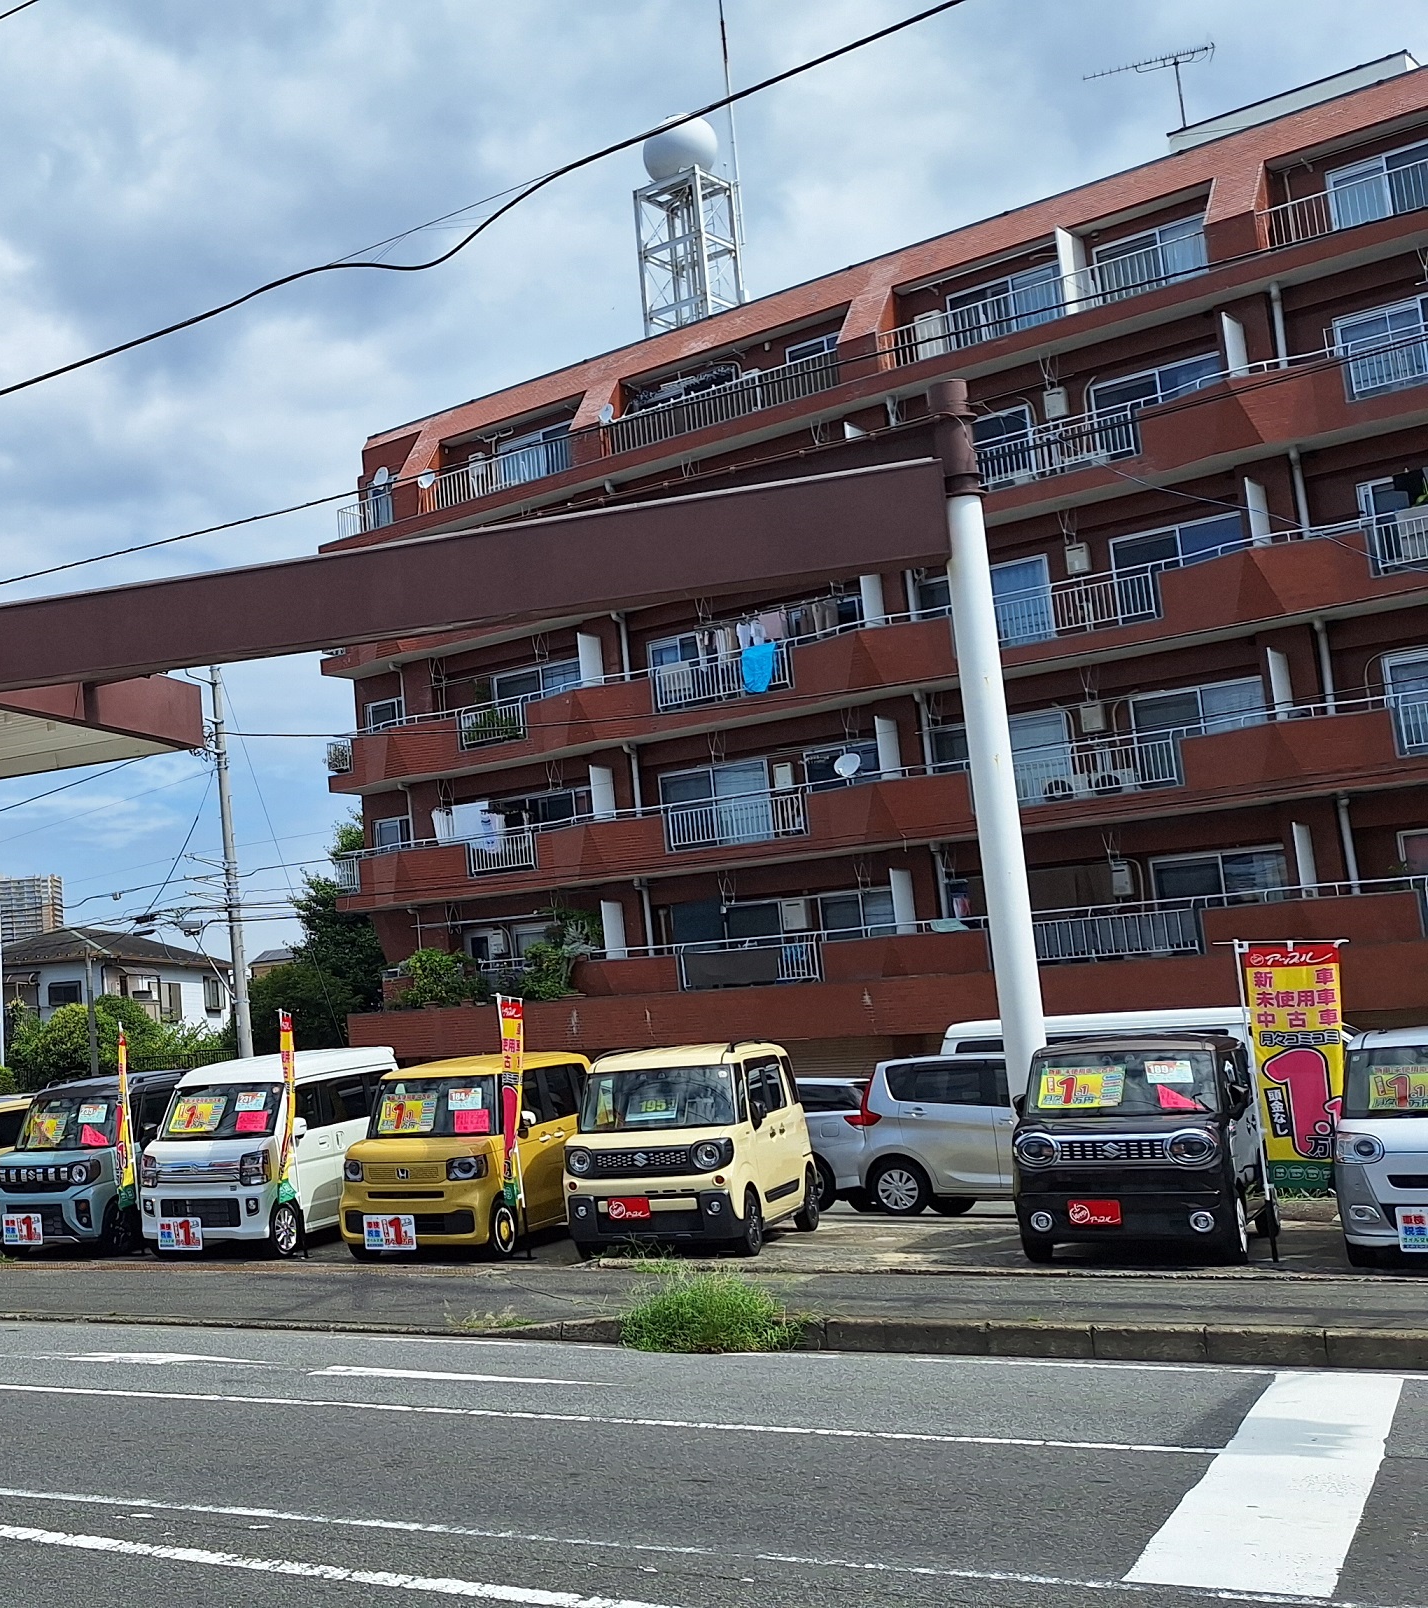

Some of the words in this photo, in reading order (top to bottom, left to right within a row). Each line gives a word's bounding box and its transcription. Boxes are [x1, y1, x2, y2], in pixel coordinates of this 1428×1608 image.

[1265, 952, 1333, 966] アップル
[1256, 988, 1336, 1009] 未使用車
[1260, 1030, 1339, 1047] 月々コミコミ
[639, 1099, 666, 1112] 195
[1267, 1089, 1288, 1135] 頭金なし
